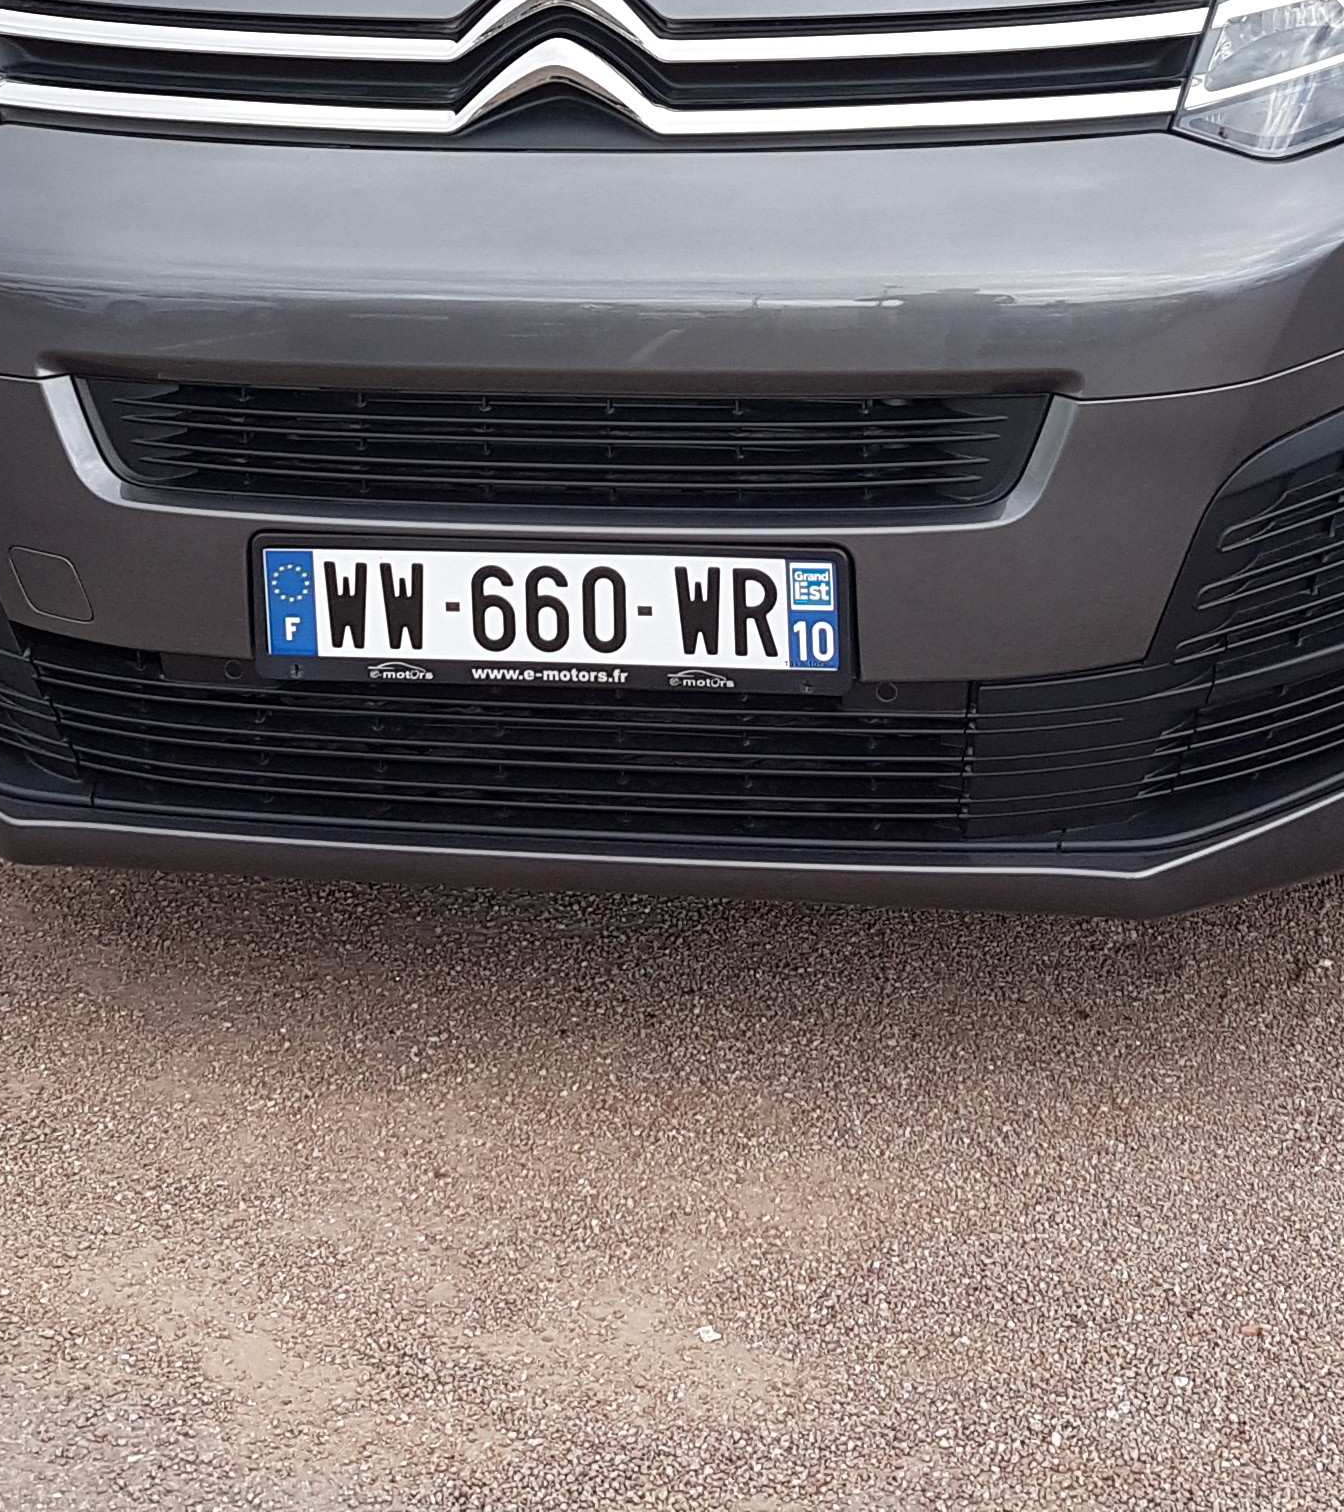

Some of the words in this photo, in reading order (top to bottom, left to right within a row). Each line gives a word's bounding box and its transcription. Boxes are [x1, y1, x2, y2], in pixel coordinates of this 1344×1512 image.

[794, 571, 829, 582] Grand
[794, 581, 830, 601] Est
[323, 561, 779, 658] WW-660-WR
[285, 617, 301, 641] F
[793, 620, 835, 662] 10
[471, 667, 629, 684] www.e-motors.fr
